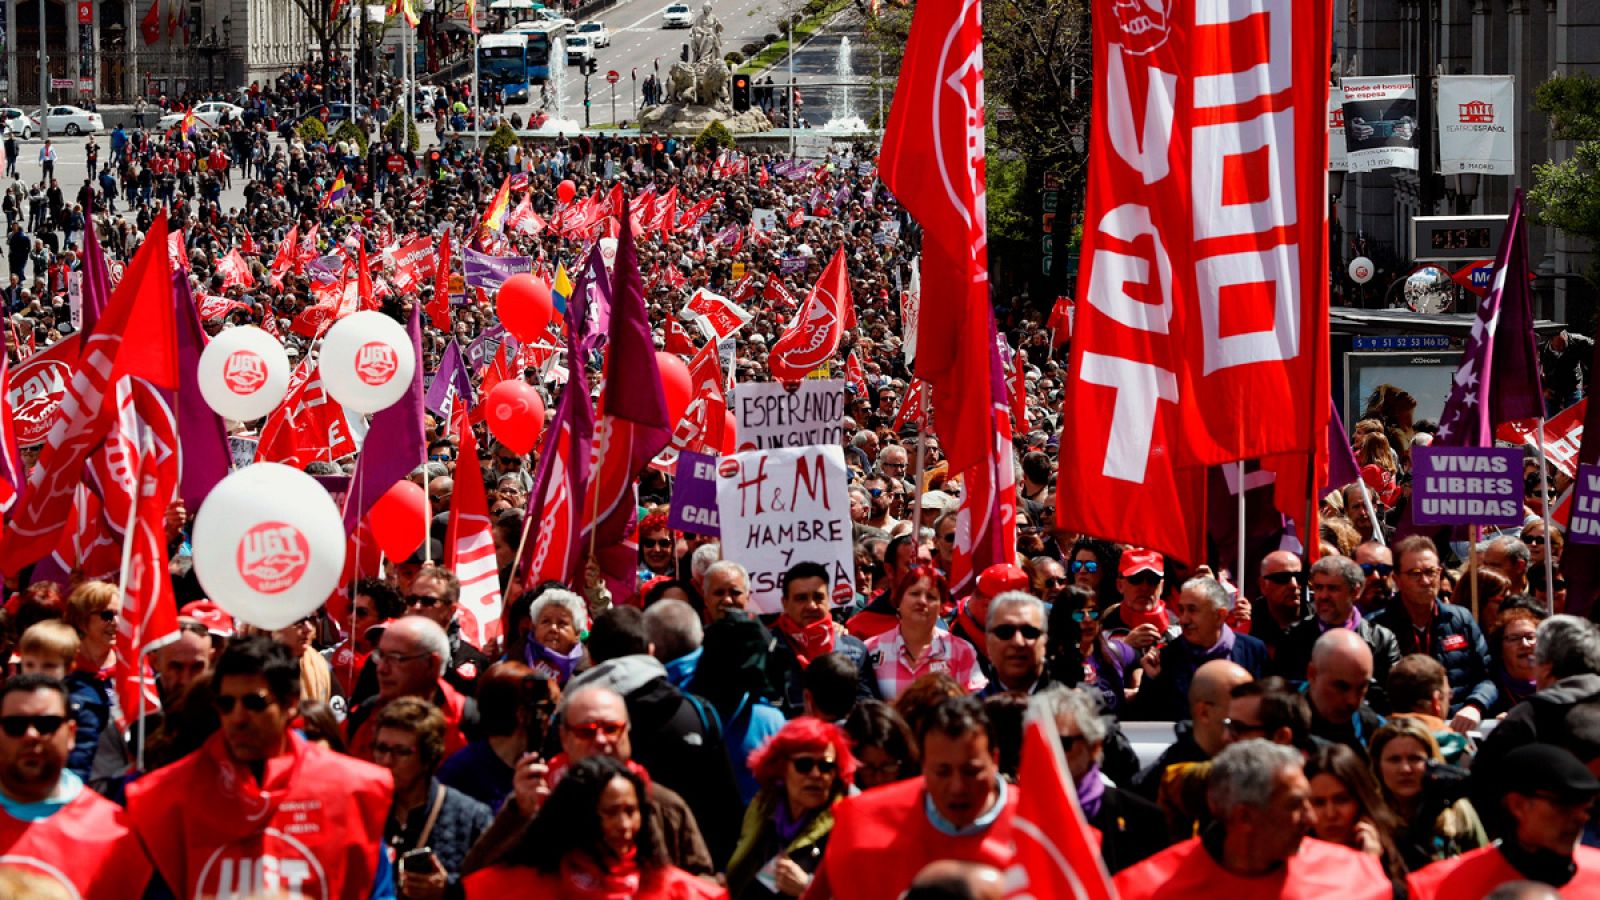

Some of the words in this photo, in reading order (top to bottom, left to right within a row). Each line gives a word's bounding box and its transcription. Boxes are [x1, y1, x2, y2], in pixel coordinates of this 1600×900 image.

[1344, 83, 1371, 92] Donde
[1357, 91, 1386, 99] espesa
[1358, 339, 1362, 347] 5
[1371, 339, 1377, 347] 9
[1383, 338, 1391, 347] 51
[1397, 338, 1406, 346] 52
[1411, 338, 1420, 346] 53
[1423, 338, 1436, 346] 146
[229, 354, 263, 374] UGT
[359, 346, 394, 367] UGT
[743, 391, 843, 428] ESPERANDO
[1430, 455, 1508, 473] VIVAS
[1426, 476, 1513, 494] LIBRES
[1421, 498, 1517, 517] UNIDAS
[746, 519, 843, 549] HAMBRE
[243, 526, 304, 563] UGT
[780, 548, 794, 566] Y
[217, 856, 311, 900] UGT
